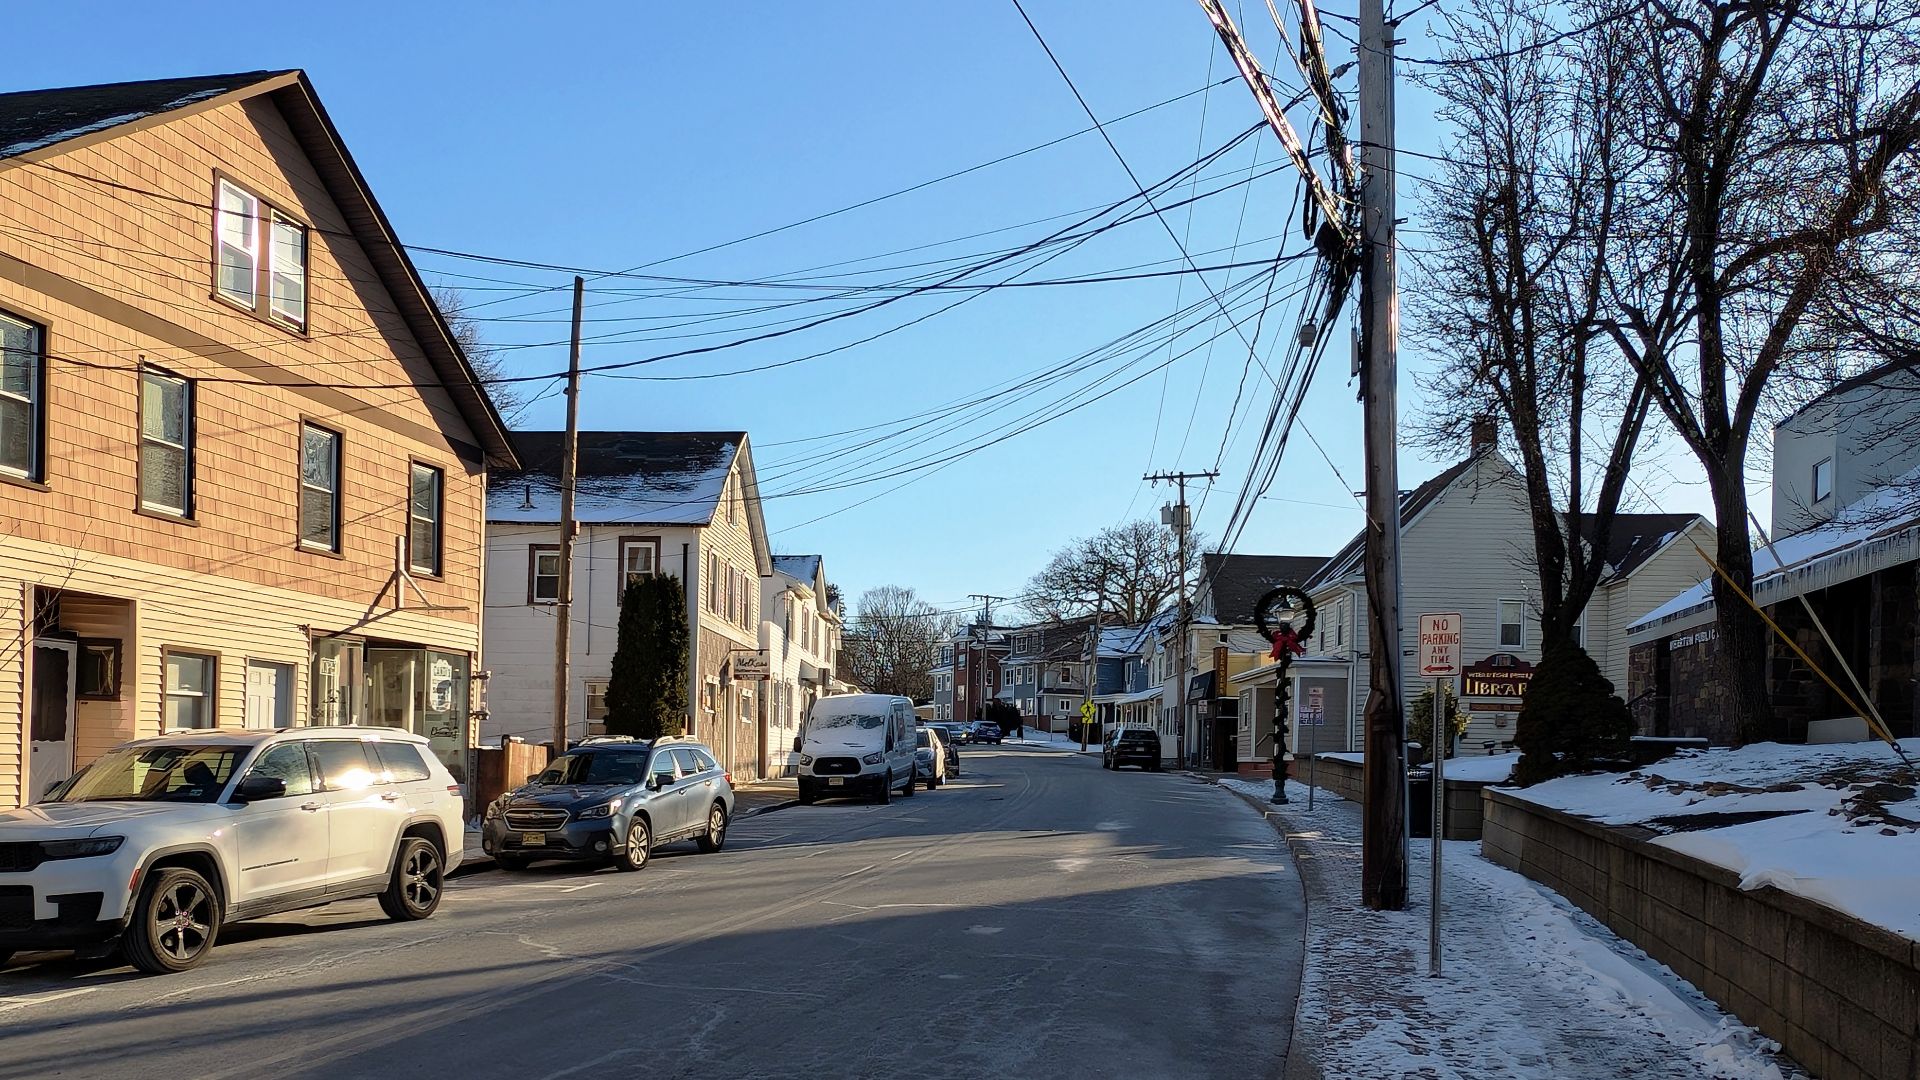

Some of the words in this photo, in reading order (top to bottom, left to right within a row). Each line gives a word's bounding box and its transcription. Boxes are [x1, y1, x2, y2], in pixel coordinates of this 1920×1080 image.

[1432, 619, 1449, 631] NO
[1422, 632, 1459, 645] PARKING
[1431, 646, 1449, 655] ANY
[1430, 655, 1450, 664] TIME
